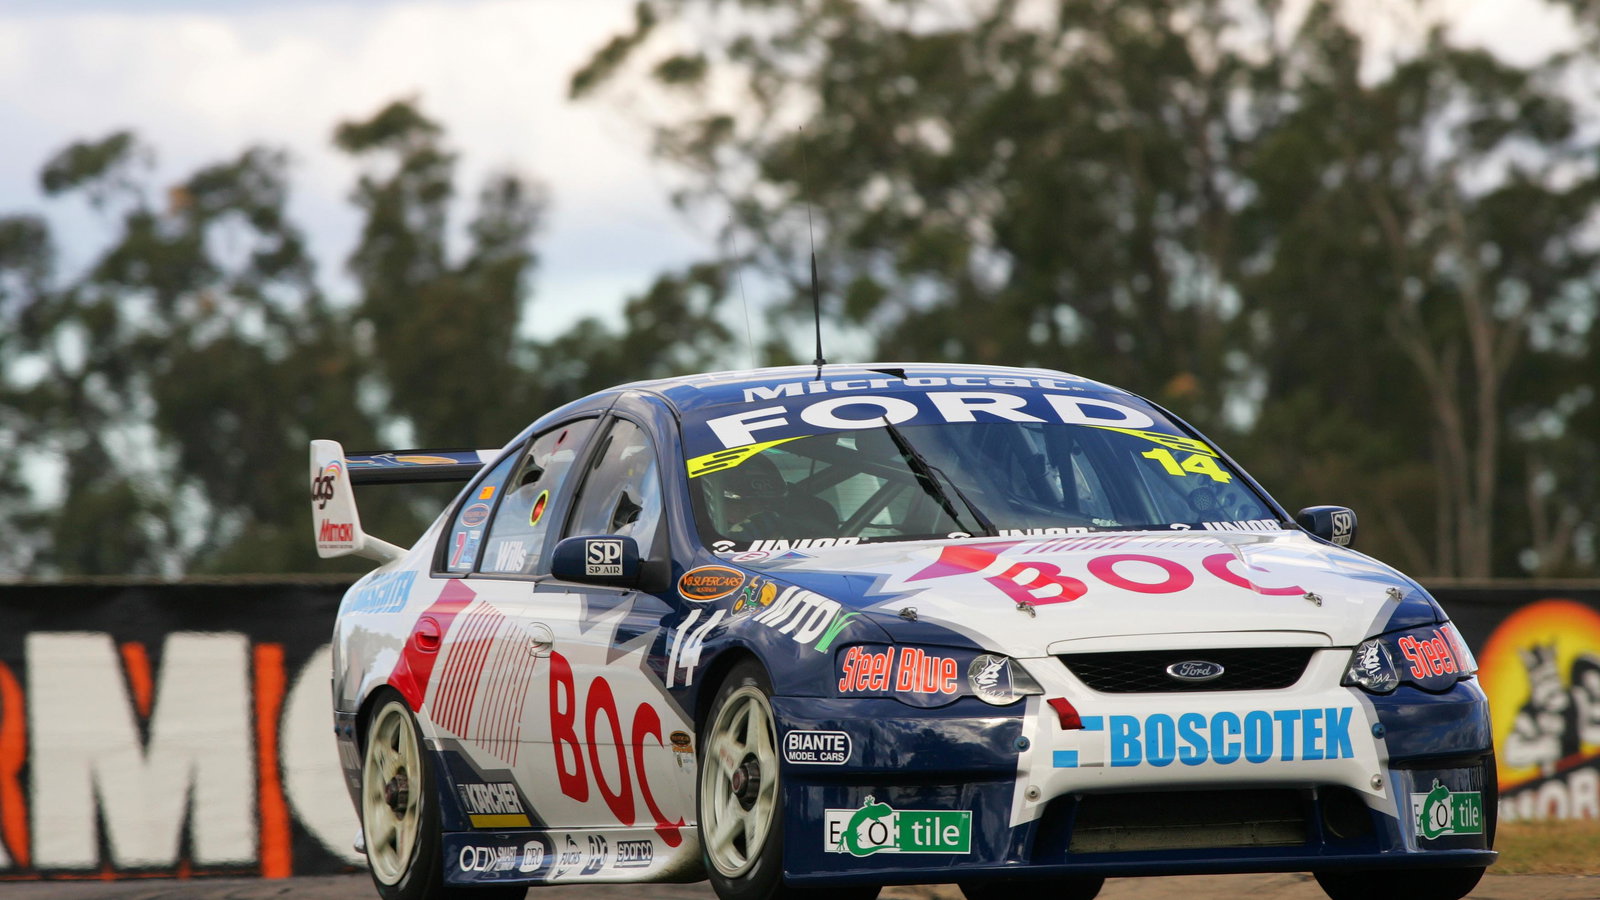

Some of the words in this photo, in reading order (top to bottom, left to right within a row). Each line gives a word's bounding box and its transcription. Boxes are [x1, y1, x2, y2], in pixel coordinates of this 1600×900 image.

[742, 376, 1071, 403] Microcat
[705, 391, 1155, 449] FORD
[1141, 448, 1233, 484] 14
[1333, 513, 1351, 536] SP
[494, 541, 527, 572] Wills
[588, 541, 621, 564] SP
[588, 565, 601, 574] SP
[603, 566, 621, 574] AIR
[984, 553, 1310, 607] BOC
[666, 608, 728, 689] 14
[1398, 628, 1459, 680] Steel
[838, 646, 896, 693] Steel
[895, 647, 958, 695] Blue
[1180, 662, 1212, 677] Ford
[549, 650, 686, 848] BOC
[788, 734, 846, 752] BIANTE
[1109, 706, 1355, 768] BOSCOTEK
[788, 751, 819, 762] MODEL
[819, 751, 845, 762] CARS
[911, 816, 961, 847] tile
[616, 841, 654, 867] sparco
